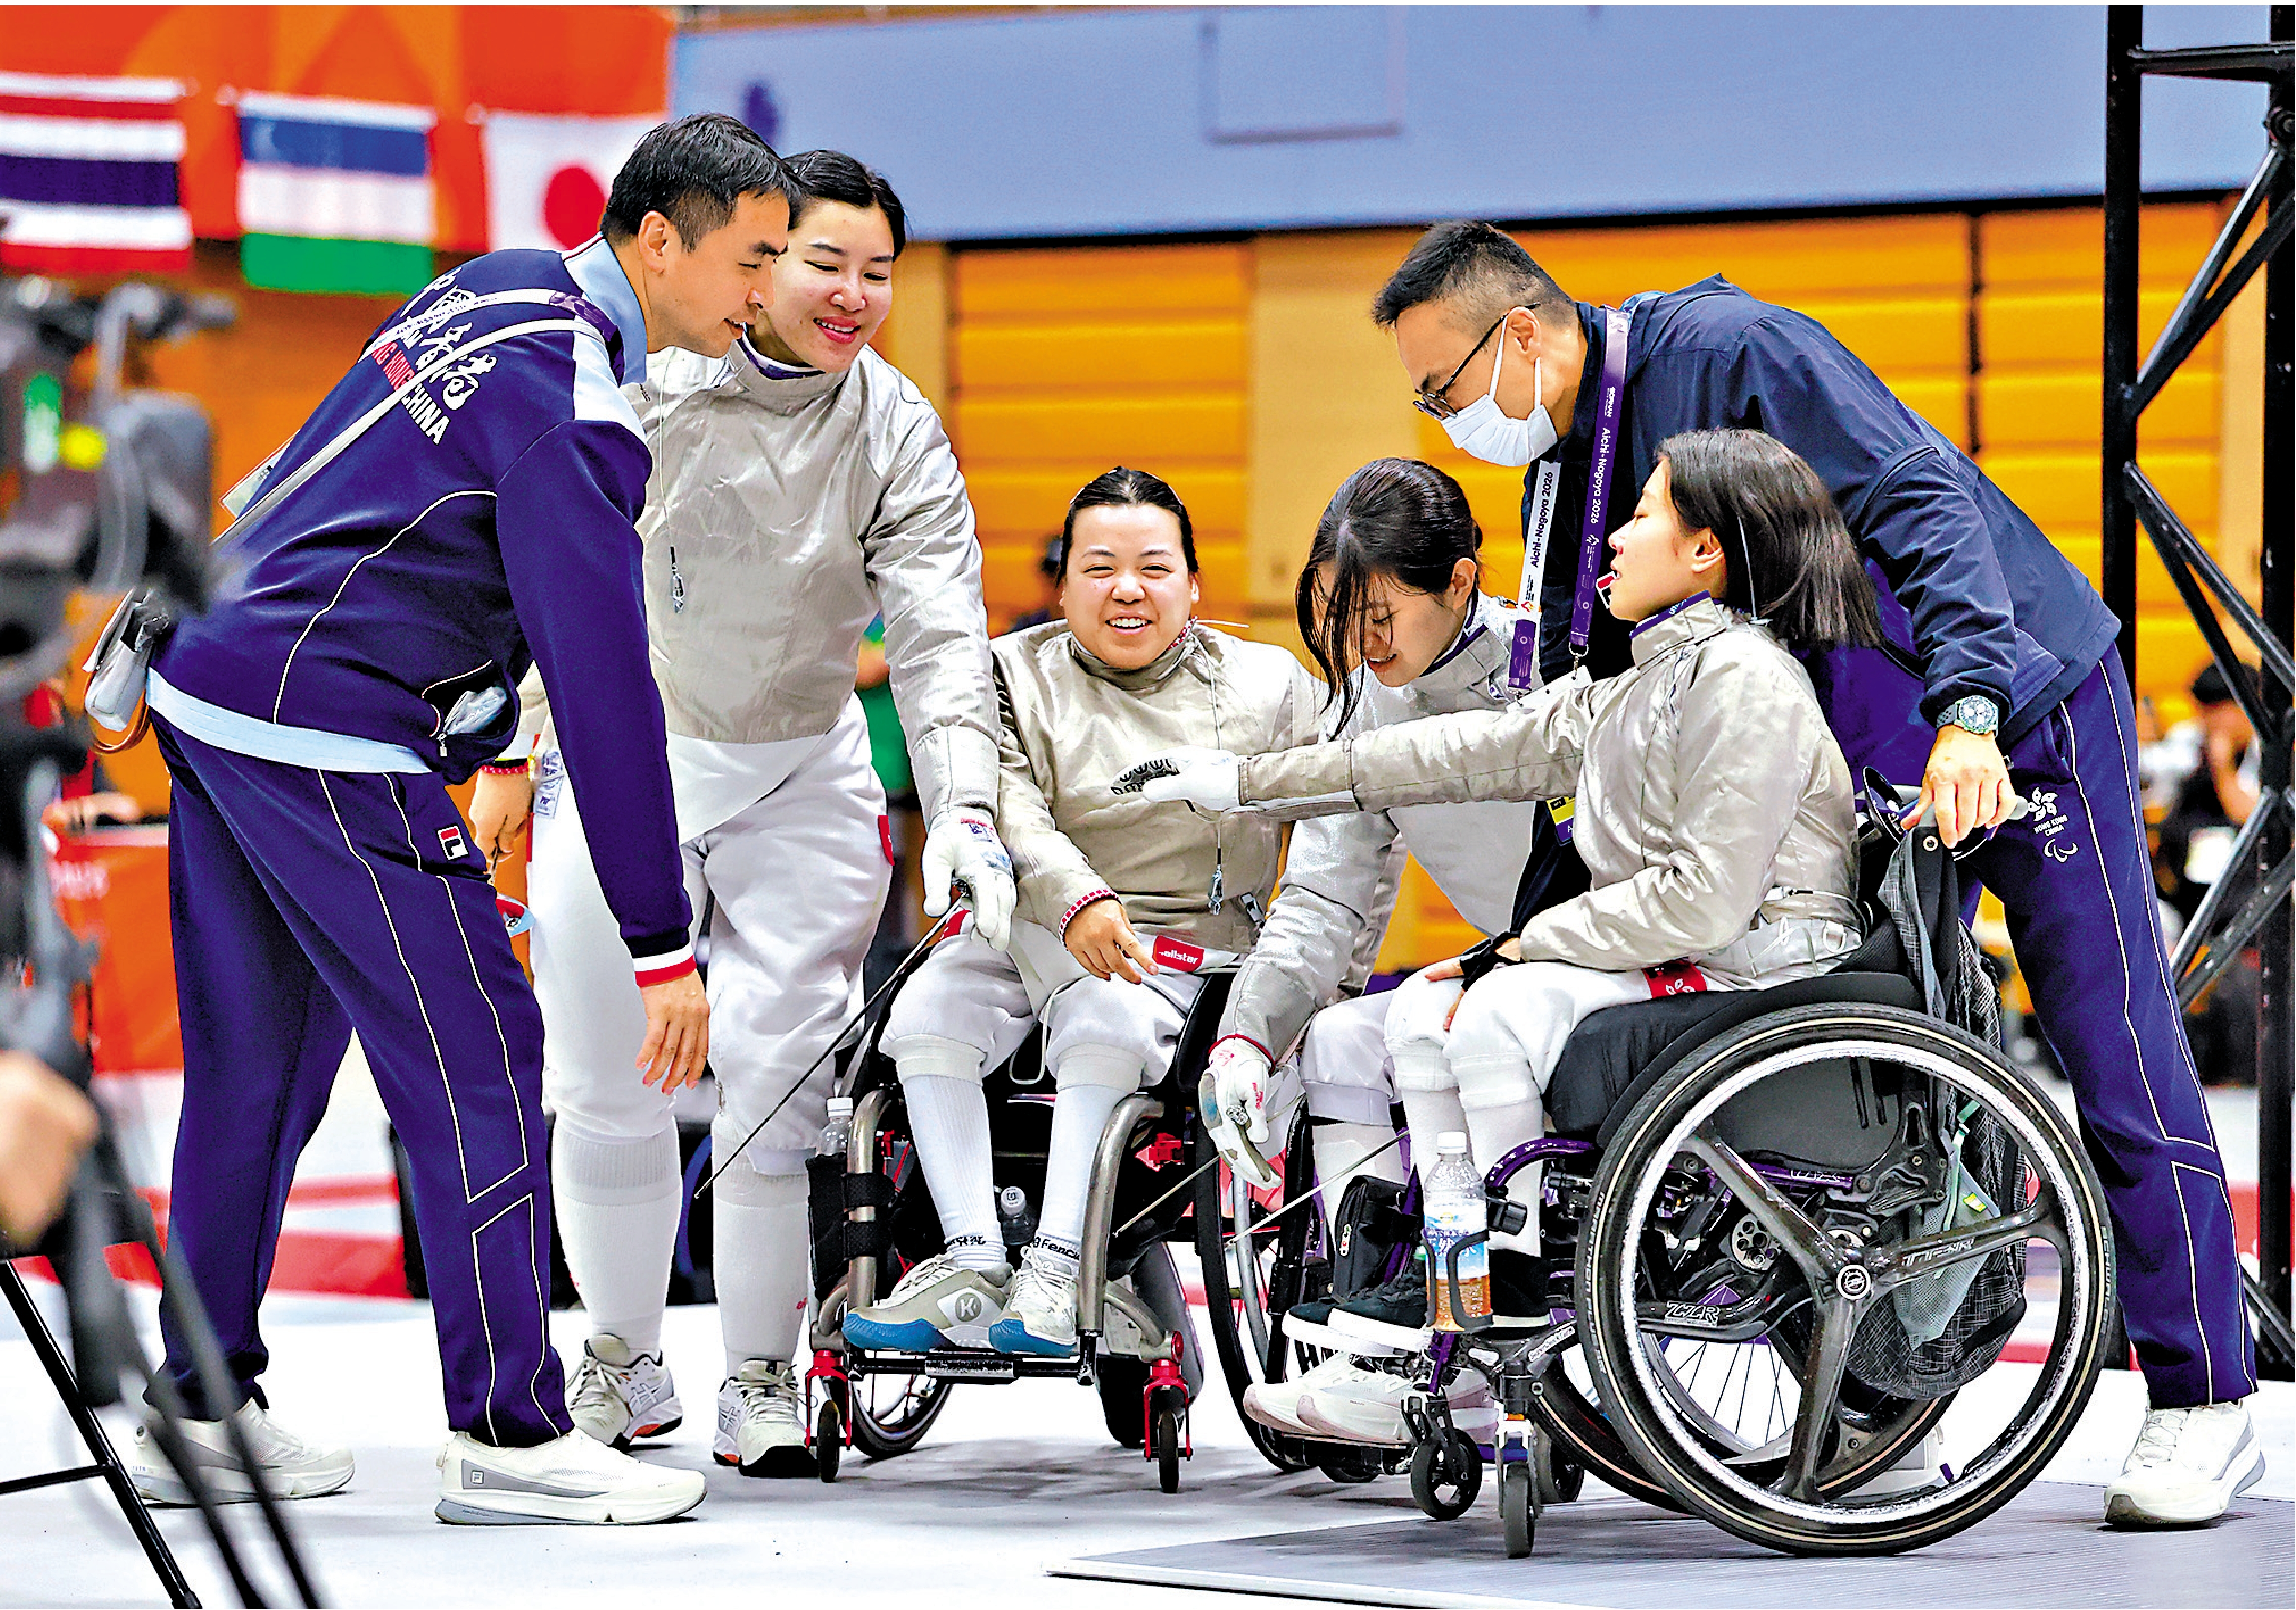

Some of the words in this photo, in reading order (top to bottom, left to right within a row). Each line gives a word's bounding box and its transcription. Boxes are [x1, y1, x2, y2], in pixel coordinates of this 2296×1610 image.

[1594, 427, 1610, 496] Aichi-Nagoya
[1530, 499, 1549, 568] Aichi-Nagoya
[1542, 472, 1554, 497] 2026
[1591, 499, 1602, 524] 2026
